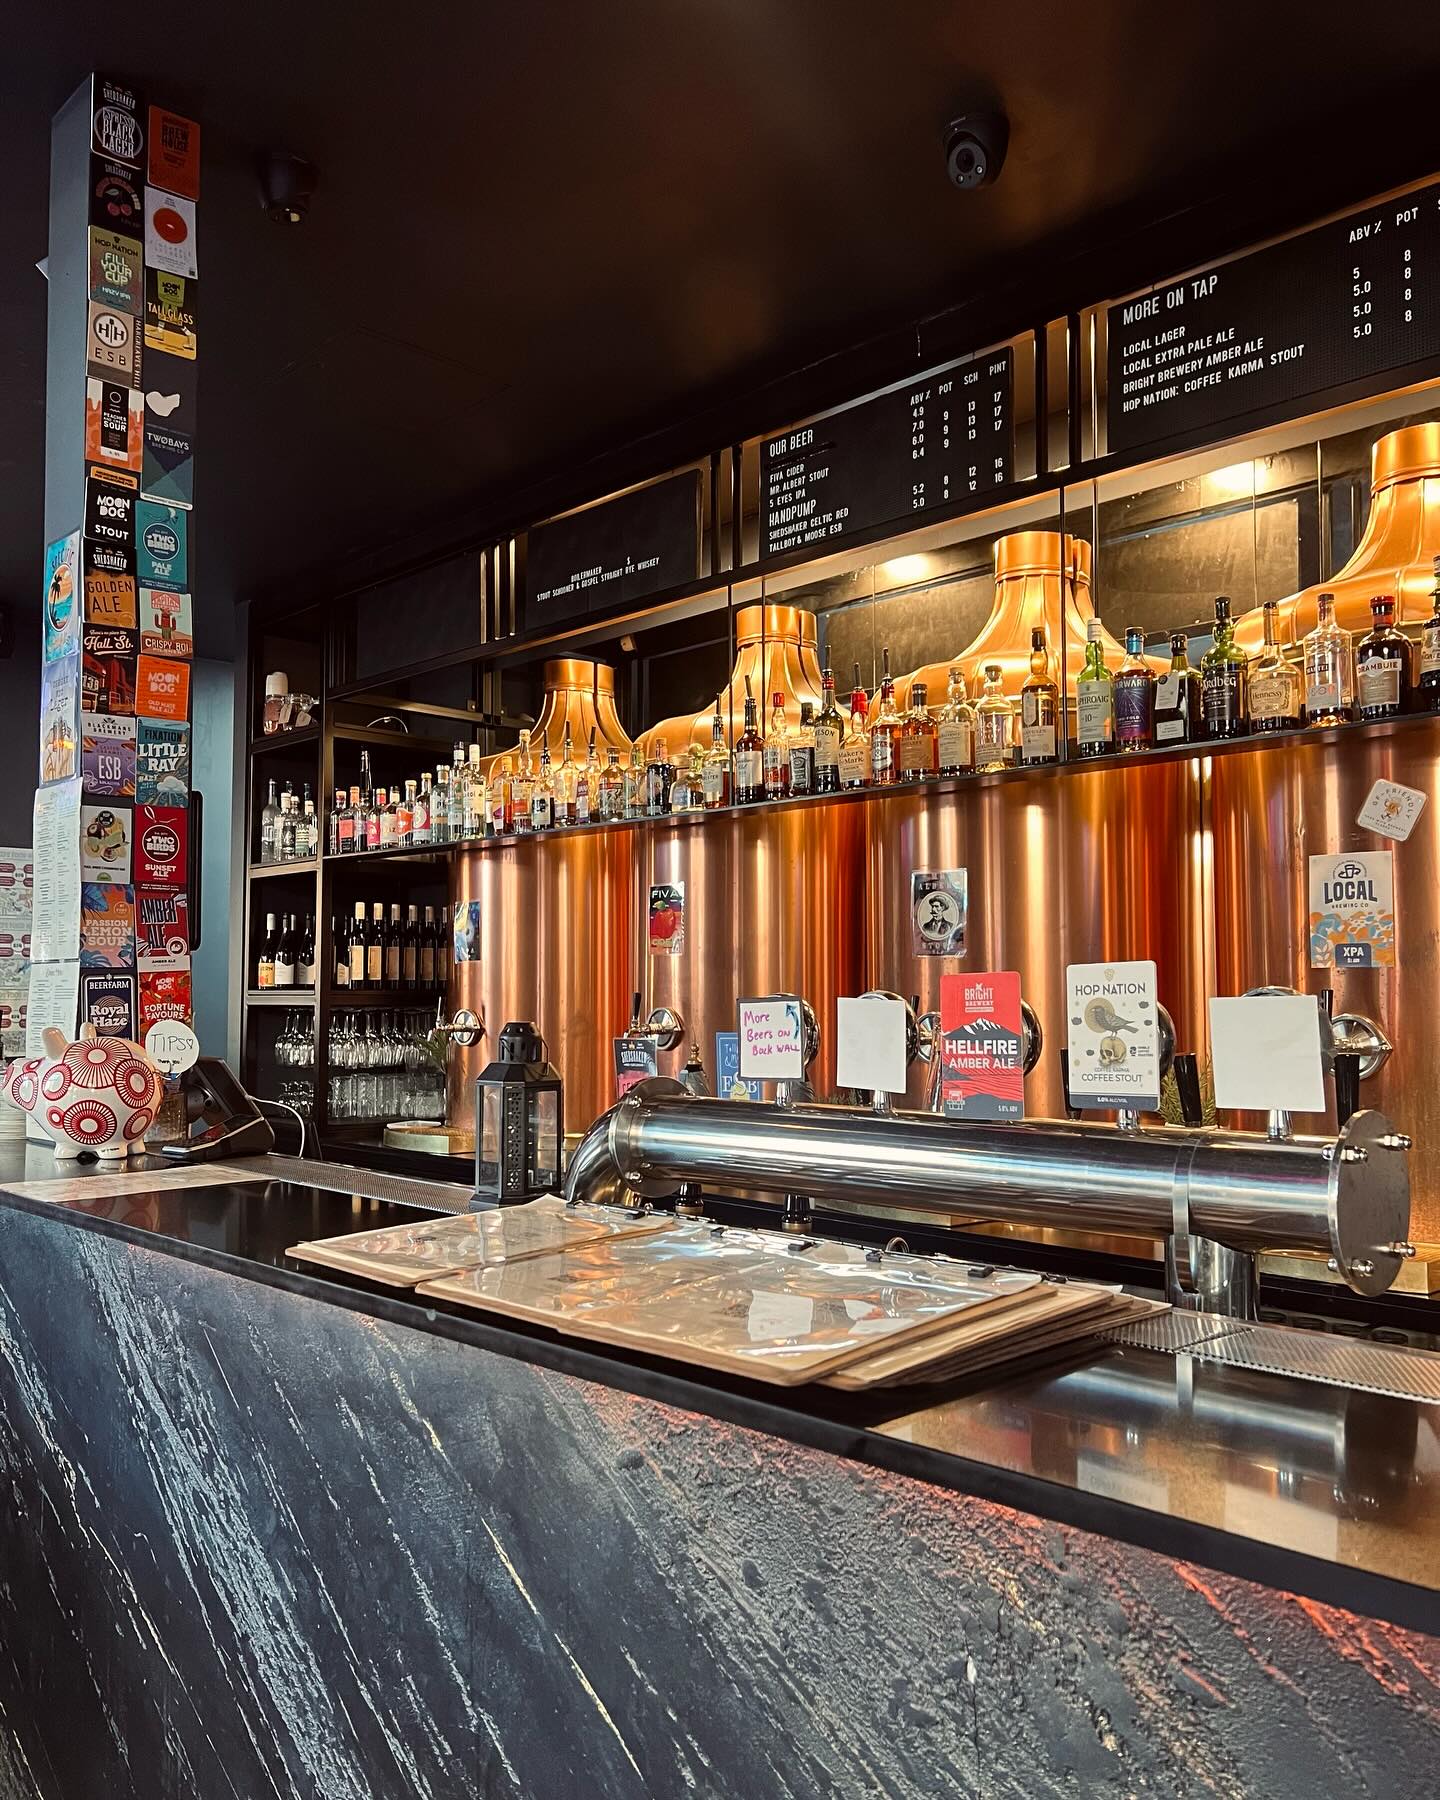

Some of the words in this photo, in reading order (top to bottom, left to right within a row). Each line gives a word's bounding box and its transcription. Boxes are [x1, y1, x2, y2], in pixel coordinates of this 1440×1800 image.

[103, 107, 135, 128] ESPRESSO
[103, 119, 134, 144] BLACK
[102, 133, 134, 159] LAGER
[1349, 225, 1370, 243] ABV
[1374, 220, 1382, 234] %
[1396, 207, 1418, 226] POT
[95, 237, 111, 252] HOP
[112, 242, 138, 257] NATION
[105, 252, 128, 267] FILL
[1404, 249, 1411, 262] 8
[101, 259, 132, 278] YOUR
[1353, 267, 1360, 279] 5
[1405, 267, 1411, 279] 8
[105, 271, 128, 287] CUP
[1353, 281, 1371, 296] 5.0
[1405, 288, 1412, 301] 8
[1123, 296, 1160, 325] MORE
[1166, 288, 1184, 309] ON
[1192, 275, 1218, 300] TAP
[1353, 302, 1371, 317] 5.0
[1405, 310, 1412, 322] 8
[1353, 323, 1372, 338] 5.0
[1123, 339, 1152, 357] LOCAL
[1155, 326, 1185, 346] LAGER
[1123, 357, 1152, 376] LOCAL
[1155, 346, 1185, 365] EXTRA
[1188, 336, 1213, 355] PALE
[1216, 328, 1235, 344] ALE
[1123, 374, 1155, 395] BRIGHT
[1158, 358, 1203, 383] BREWERY
[1206, 346, 1241, 367] AMBER
[1244, 337, 1264, 354] ALE
[910, 393, 923, 406] ABV
[925, 390, 931, 400] %
[939, 381, 952, 395] POT
[964, 372, 978, 385] SCH
[989, 360, 1006, 376] PINT
[1123, 398, 1140, 413] HOP
[1143, 386, 1179, 406] NATION:
[1184, 371, 1222, 393] COFFEE
[1228, 357, 1264, 380] KARMA
[1270, 344, 1304, 365] STOUT
[913, 407, 924, 417] 4.9
[943, 411, 949, 421] 9
[968, 401, 975, 412] 13
[994, 392, 1001, 402] 17
[104, 421, 126, 432] SOUR
[912, 421, 924, 432] 7.0
[943, 425, 949, 435] 9
[968, 415, 976, 426] 13
[994, 405, 1002, 417] 17
[912, 434, 924, 445] 6.0
[944, 439, 949, 449] 9
[968, 429, 976, 440] 13
[994, 420, 1002, 431] 17
[770, 439, 787, 458] OUR
[790, 429, 813, 450] BEER
[912, 448, 924, 460] 6.4
[770, 470, 784, 483] FIVA
[786, 464, 804, 478] CIDER
[809, 468, 829, 482] STOUT
[913, 483, 925, 495] 5.2
[944, 475, 949, 485] 8
[969, 466, 976, 477] 12
[995, 458, 1003, 469] 16
[770, 499, 774, 508] 5
[776, 493, 792, 505] EYES
[796, 488, 806, 500] IPA
[913, 497, 925, 509] 5.0
[944, 489, 949, 499] 8
[969, 480, 977, 491] 12
[995, 472, 1003, 483] 16
[97, 495, 130, 510] MOON
[769, 500, 816, 527] HANDPUMP
[769, 521, 807, 540] SHEDSHAKER
[810, 513, 832, 528] CELTIC
[836, 508, 849, 520] RED
[95, 524, 129, 540] STOUT
[152, 533, 175, 543] TWO
[769, 536, 796, 553] TALLBOY
[797, 535, 802, 544] &
[804, 529, 826, 542] MOOSE
[829, 523, 842, 534] ESB
[148, 539, 175, 552] BIRDS
[151, 561, 172, 571] PALE
[154, 568, 170, 576] ALE
[537, 591, 551, 602] STOUT
[552, 584, 574, 597] SCHOONER
[576, 582, 580, 590] &
[582, 578, 599, 588] GOSPEL
[601, 568, 623, 583] STRAIGHT
[625, 564, 635, 575] RYE
[638, 557, 660, 571] WHISKEY
[571, 566, 602, 583] BOILERMAKER
[88, 581, 133, 593] GOLDEN
[93, 596, 122, 613] ALE
[84, 636, 113, 651] Hall
[114, 635, 134, 650] St.
[145, 638, 172, 649] CRISPY
[176, 642, 189, 652] BOI
[1358, 661, 1398, 674] DRAMBUIE
[148, 672, 180, 684] MOON
[1252, 691, 1282, 699] Hennessy
[1084, 714, 1092, 722] 10
[88, 722, 131, 731] BLACKMANS
[145, 729, 182, 742] FIXATION
[139, 743, 187, 757] LITTLE
[98, 755, 121, 780] ESB
[148, 758, 179, 772] RAY
[147, 842, 175, 852] BIRDS
[151, 835, 175, 845] TWO
[145, 863, 176, 872] SUNSET
[152, 870, 169, 878] ALE
[652, 890, 678, 899] FIVA
[1324, 880, 1378, 904] LOCAL
[83, 927, 132, 936] LEMON
[1343, 947, 1364, 957] XPA
[89, 981, 129, 990] BEERFARM
[156, 978, 175, 986] MOON
[1075, 984, 1100, 996] HOP
[1103, 983, 1146, 995] NATION
[965, 987, 993, 1000] BRIGHT
[90, 1003, 129, 1016] Royal
[144, 1003, 185, 1012] FORTUNE
[93, 1016, 128, 1027] Haze
[146, 1012, 185, 1020] FAVOURS
[744, 1011, 770, 1026] More
[747, 1028, 772, 1042] Beers
[778, 1029, 790, 1038] ON
[151, 1033, 186, 1053] TIPS
[752, 1045, 772, 1056] Back
[777, 1044, 800, 1053] WALL
[945, 1039, 1017, 1055] HELLFIRE
[949, 1058, 990, 1068] AMBER
[993, 1058, 1015, 1068] ALE
[1082, 1073, 1113, 1082] COFFEE
[1115, 1074, 1143, 1082] STOUT
